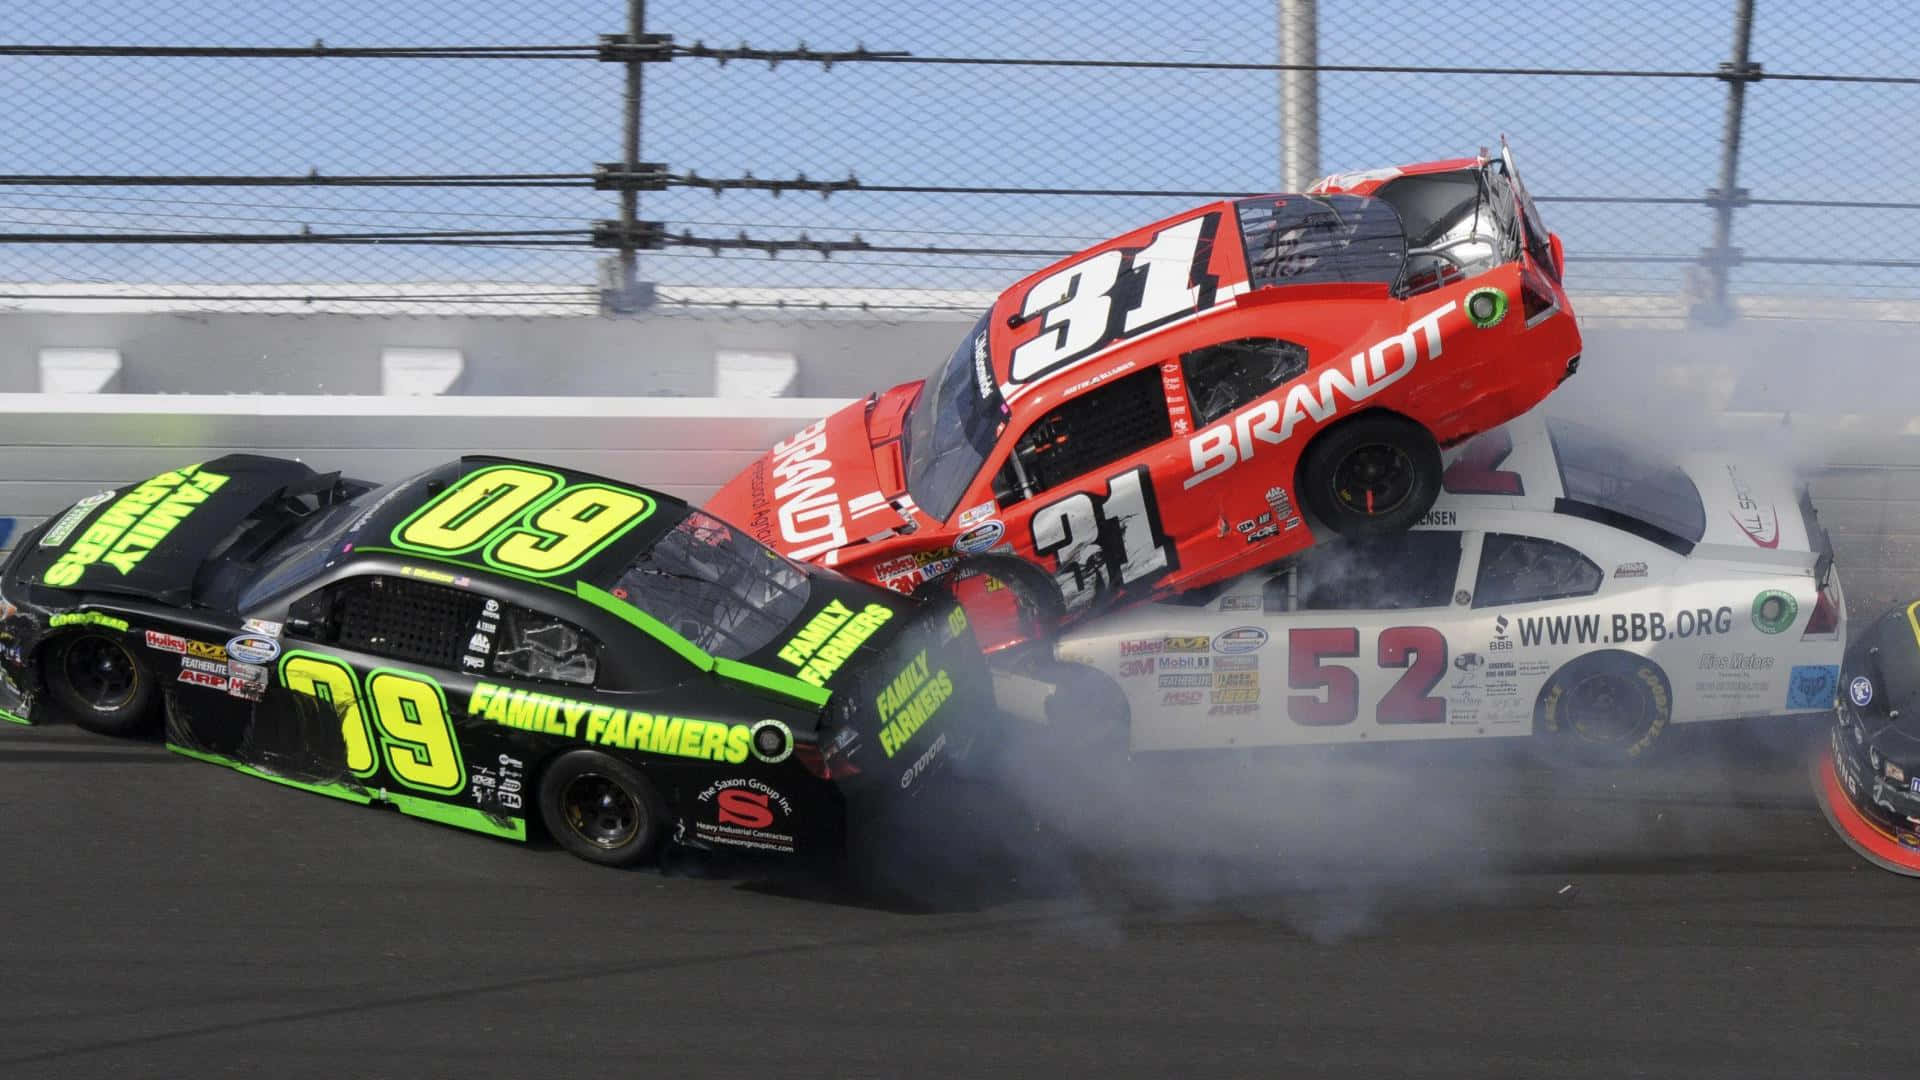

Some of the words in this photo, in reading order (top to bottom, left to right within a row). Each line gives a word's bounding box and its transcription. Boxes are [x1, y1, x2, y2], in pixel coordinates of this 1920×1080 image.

[1010, 212, 1222, 385] 31
[1184, 300, 1457, 490] BRANDT
[772, 417, 848, 565] BRANDT
[1415, 511, 1457, 526] ENSEN
[103, 470, 232, 576] FAMILY
[390, 464, 657, 578] 09
[1030, 464, 1180, 610] 31
[887, 570, 924, 594] 3M
[147, 632, 186, 651] Holley
[777, 598, 855, 668] FAMILY
[797, 603, 895, 688] FARMERS
[1489, 641, 1513, 651] BBB
[1517, 606, 1733, 647] WWW.BBB.ORG
[180, 670, 227, 687] ARP
[182, 657, 228, 675] FEATHERLITE
[876, 648, 929, 724] FAMILY
[1120, 658, 1155, 677] 3M
[1160, 656, 1194, 669] Mobil
[1287, 626, 1448, 727] 52
[468, 682, 588, 737] FAMILY
[586, 703, 752, 764] FARMERS
[879, 669, 953, 759] FARMERS
[912, 733, 947, 778] TOYOTA
[697, 786, 717, 803] The
[714, 777, 746, 791] Saxon
[748, 778, 780, 800] Group
[696, 821, 719, 833] Heavy
[719, 825, 752, 836] Industrial
[752, 829, 793, 842] Contractors
